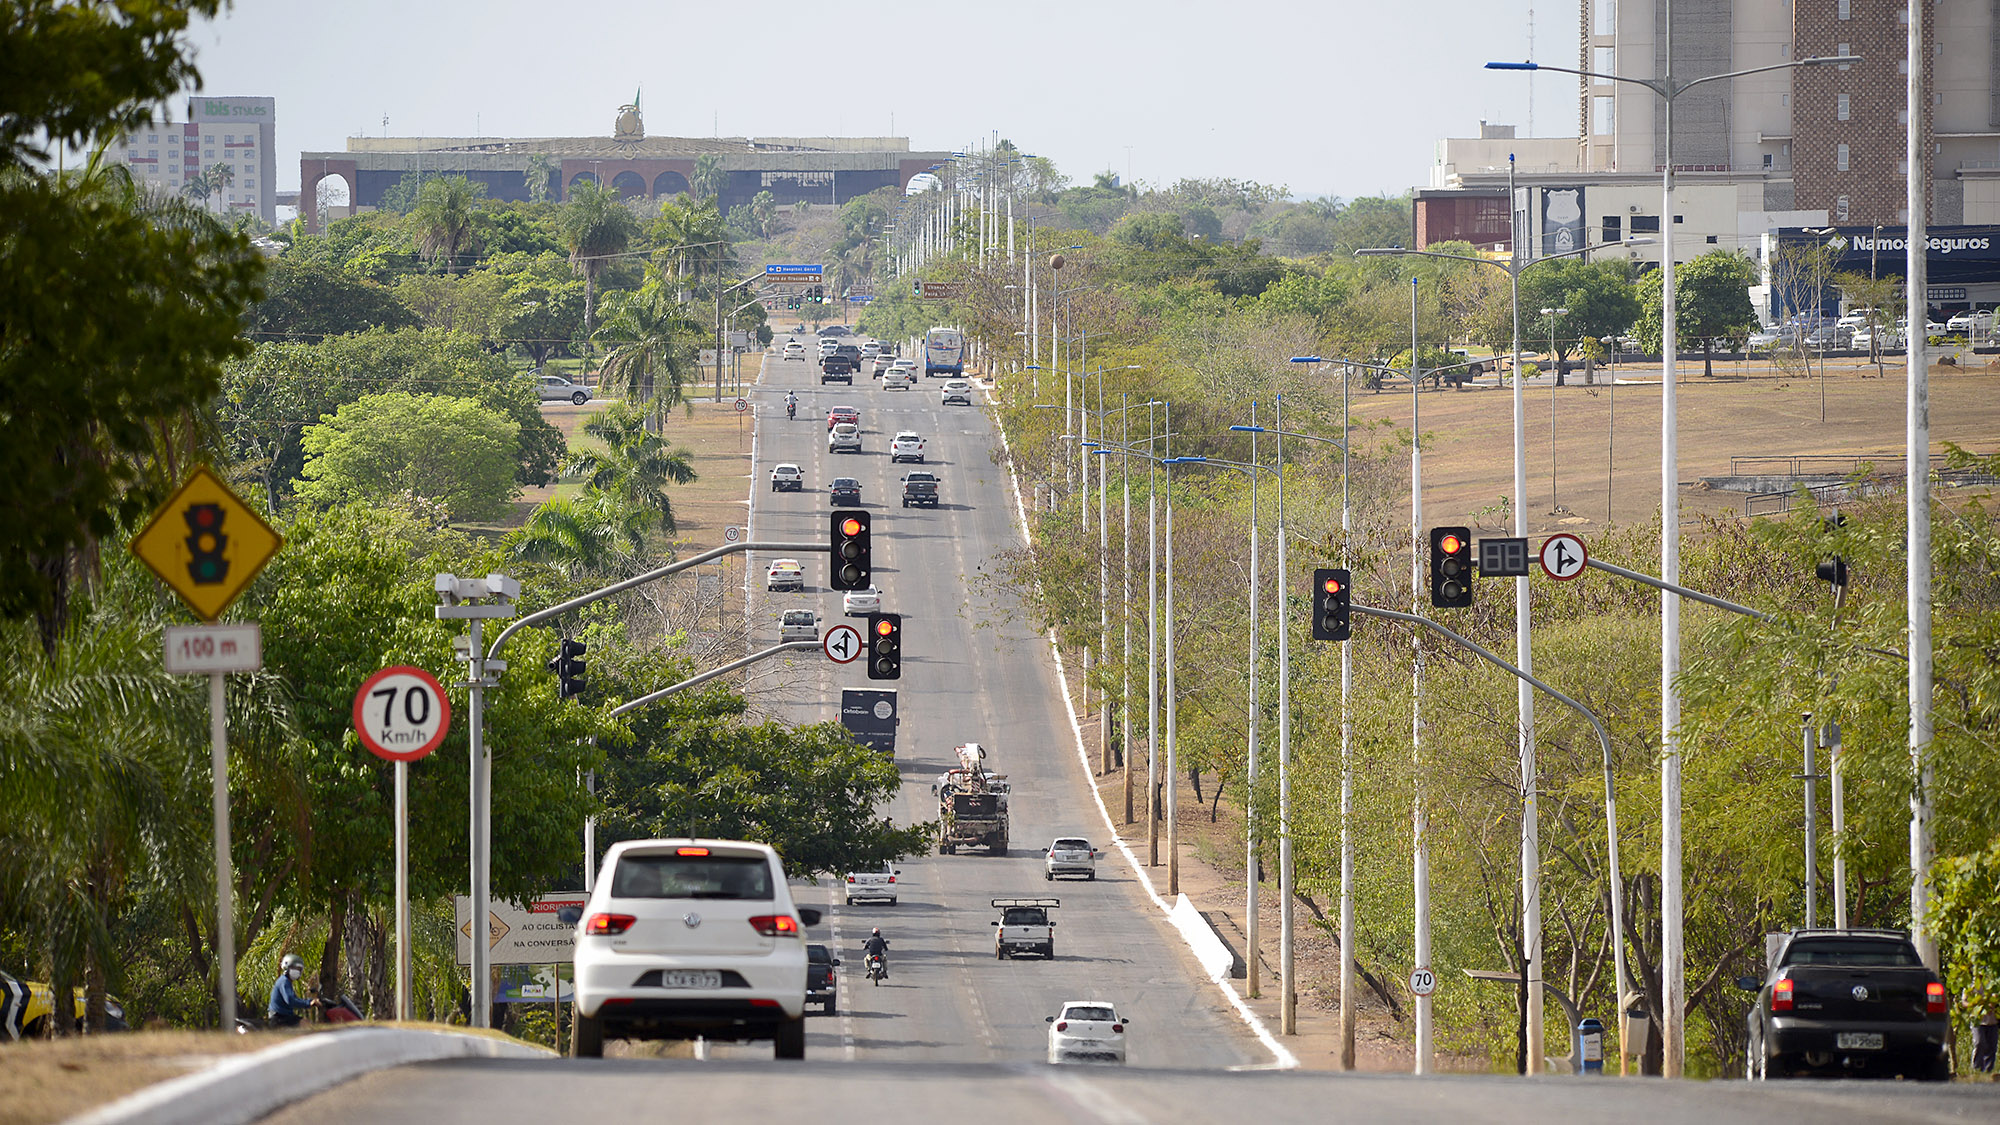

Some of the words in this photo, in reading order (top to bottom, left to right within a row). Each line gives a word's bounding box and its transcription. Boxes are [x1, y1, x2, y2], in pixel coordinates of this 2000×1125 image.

[182, 637, 215, 658] 100
[220, 640, 237, 656] m
[373, 686, 429, 727] 70
[381, 729, 427, 744] Km/h
[536, 922, 576, 931] CICLISTA
[527, 938, 575, 947] CONVERSÃ
[1415, 972, 1432, 986] 70
